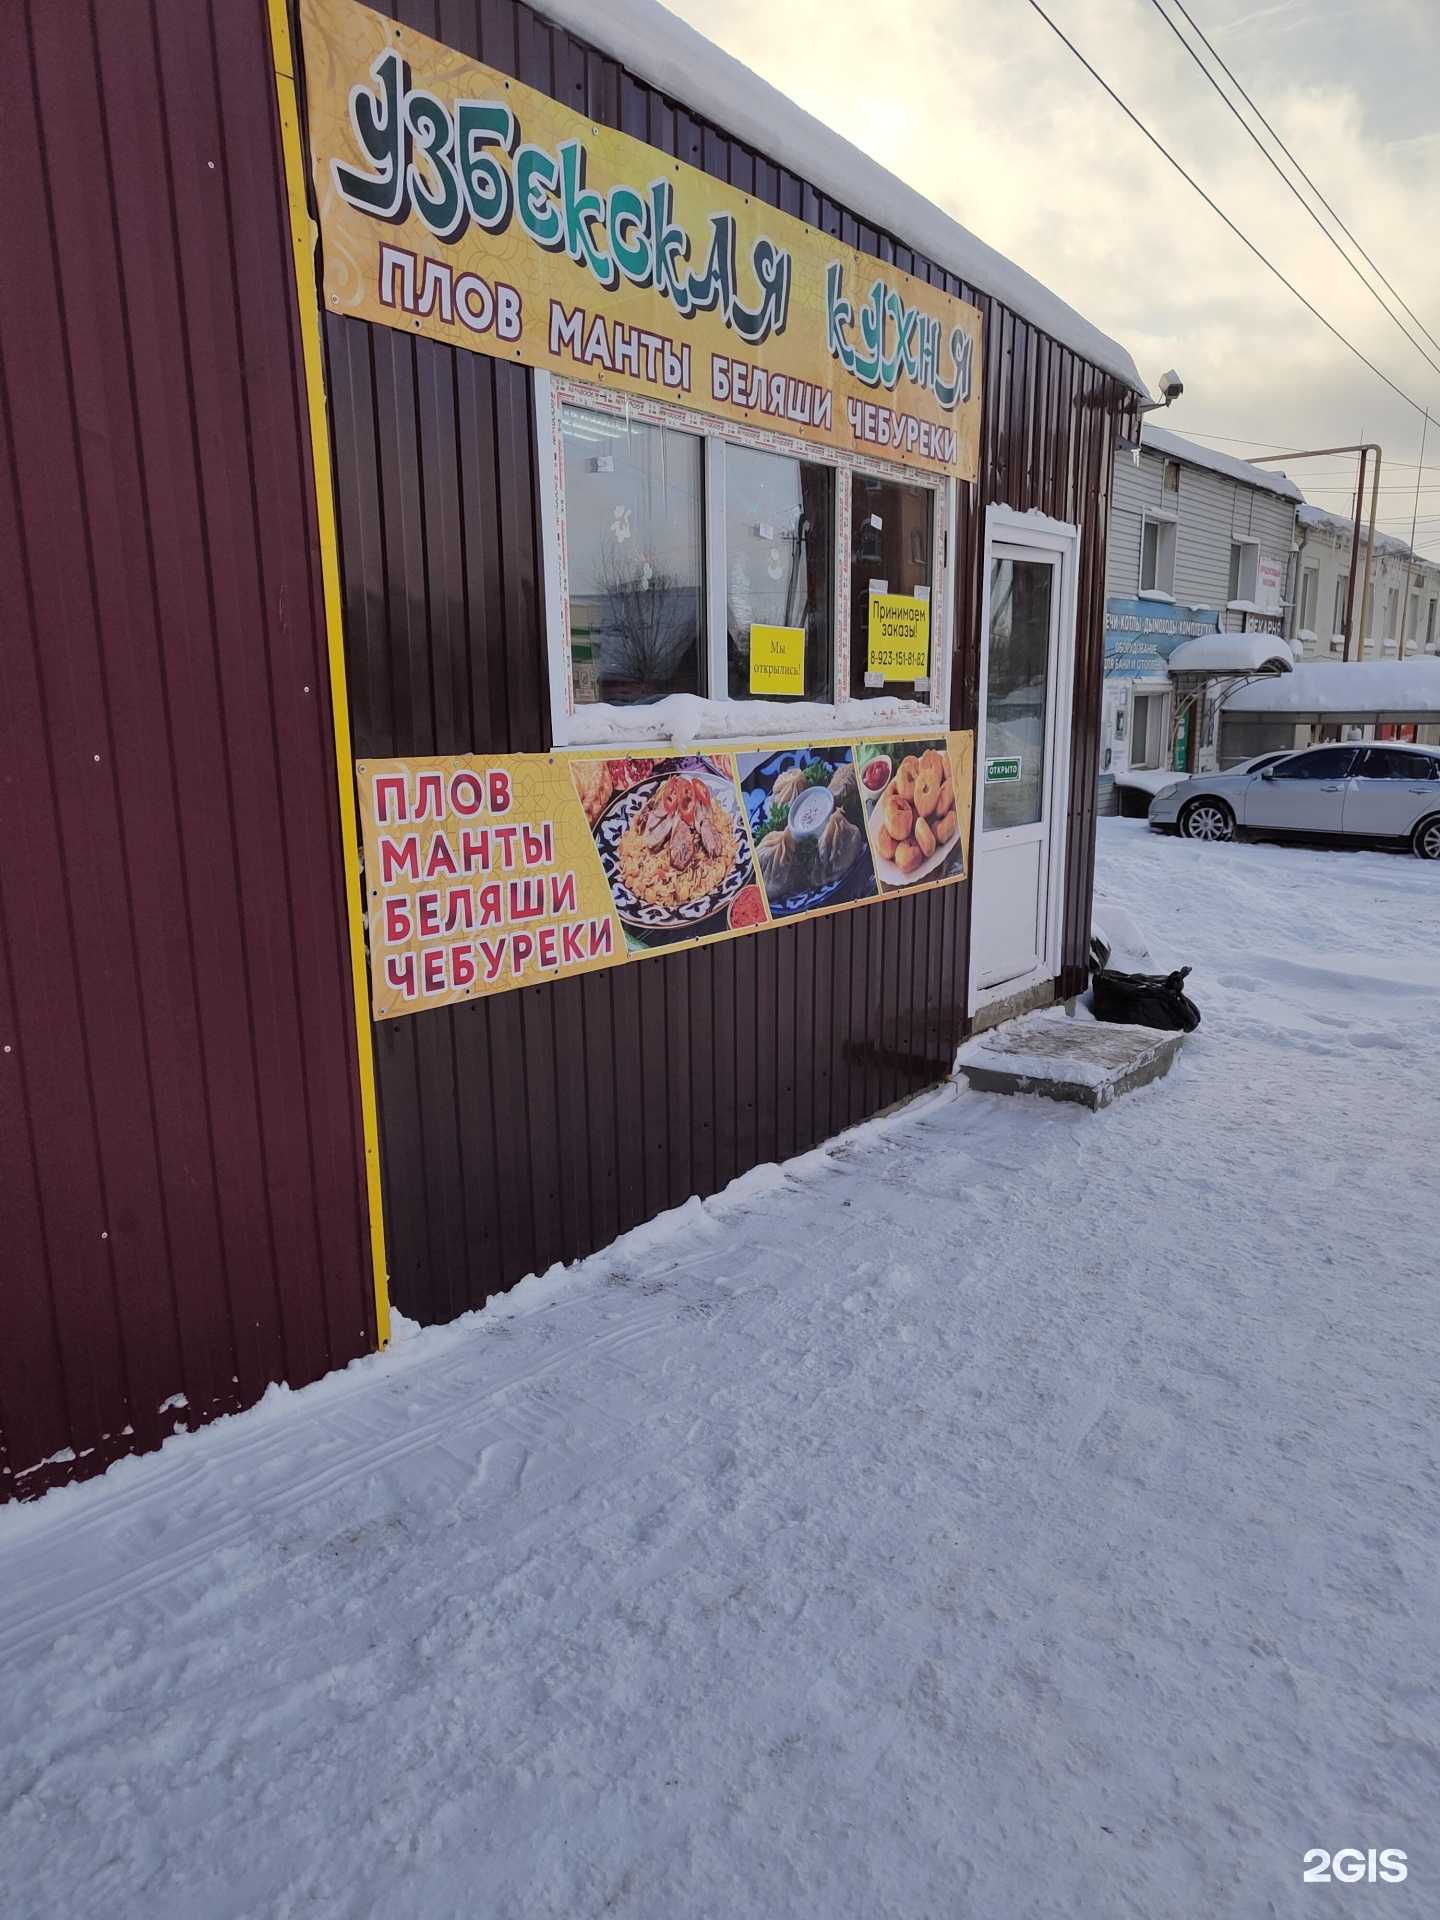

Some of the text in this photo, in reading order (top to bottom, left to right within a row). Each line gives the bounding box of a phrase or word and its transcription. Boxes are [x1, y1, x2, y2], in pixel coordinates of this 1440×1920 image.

[379, 242, 522, 342] ПЛОВ
[549, 301, 692, 392] МАНТЫ
[712, 353, 833, 432] БЕЛЯШИ
[847, 396, 957, 466] ЧЕБУРЕКИ
[873, 600, 926, 622] Принимаем
[882, 622, 918, 637] заказы!
[770, 640, 785, 654] Мы
[753, 663, 801, 678] открылись!
[989, 765, 1018, 775] ОТКРЫТО
[373, 770, 512, 825] ПЛОВ
[379, 821, 553, 884] МАНТЫ
[384, 872, 577, 944] БЕЛЯШИ
[385, 916, 613, 999] ЧЕБУРЕКИ
